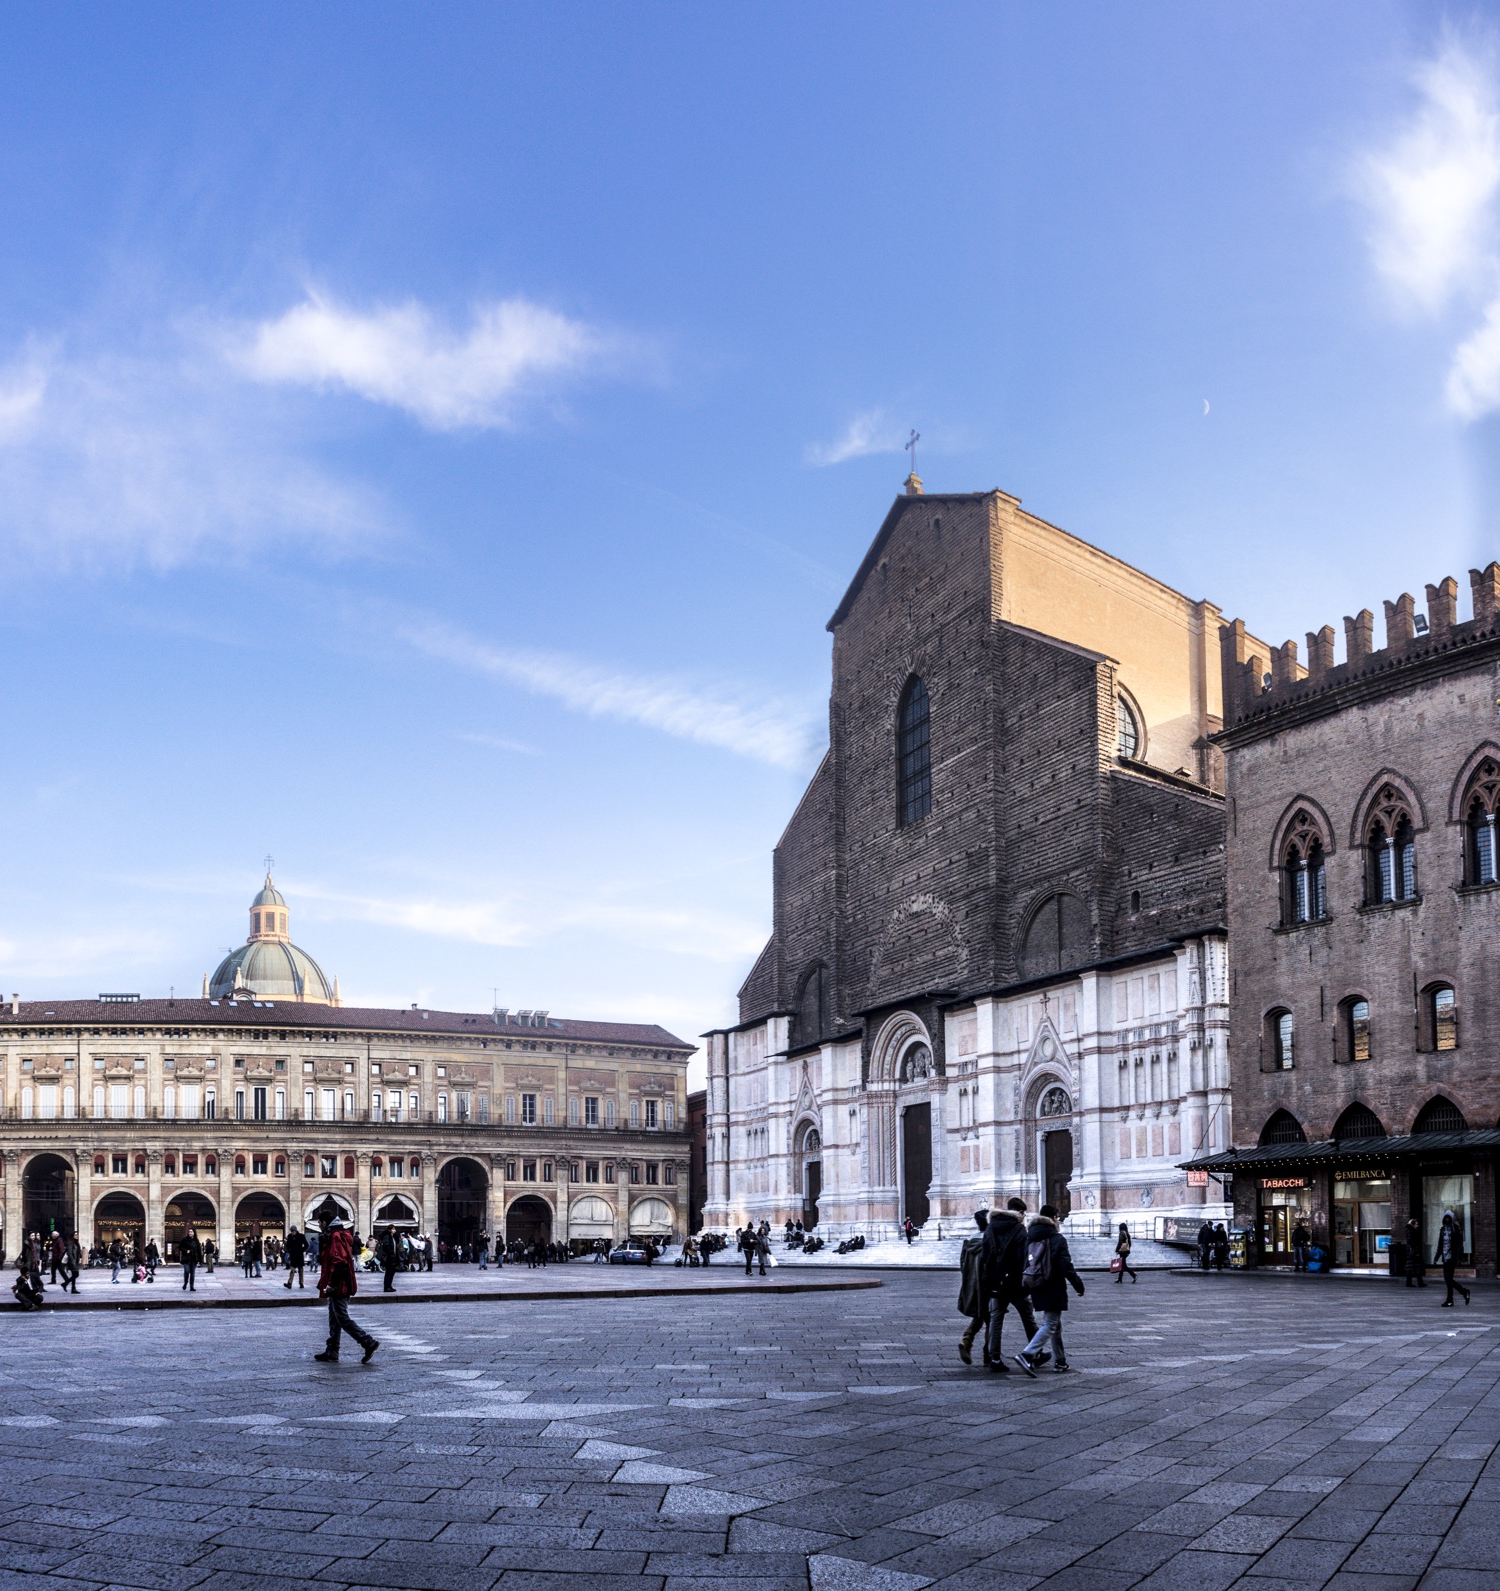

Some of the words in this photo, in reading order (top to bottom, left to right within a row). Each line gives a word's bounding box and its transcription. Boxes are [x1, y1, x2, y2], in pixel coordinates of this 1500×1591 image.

[1188, 1171, 1207, 1181] BAR
[1342, 1170, 1386, 1179] EMILBANCA
[1261, 1178, 1304, 1188] TABACCHI
